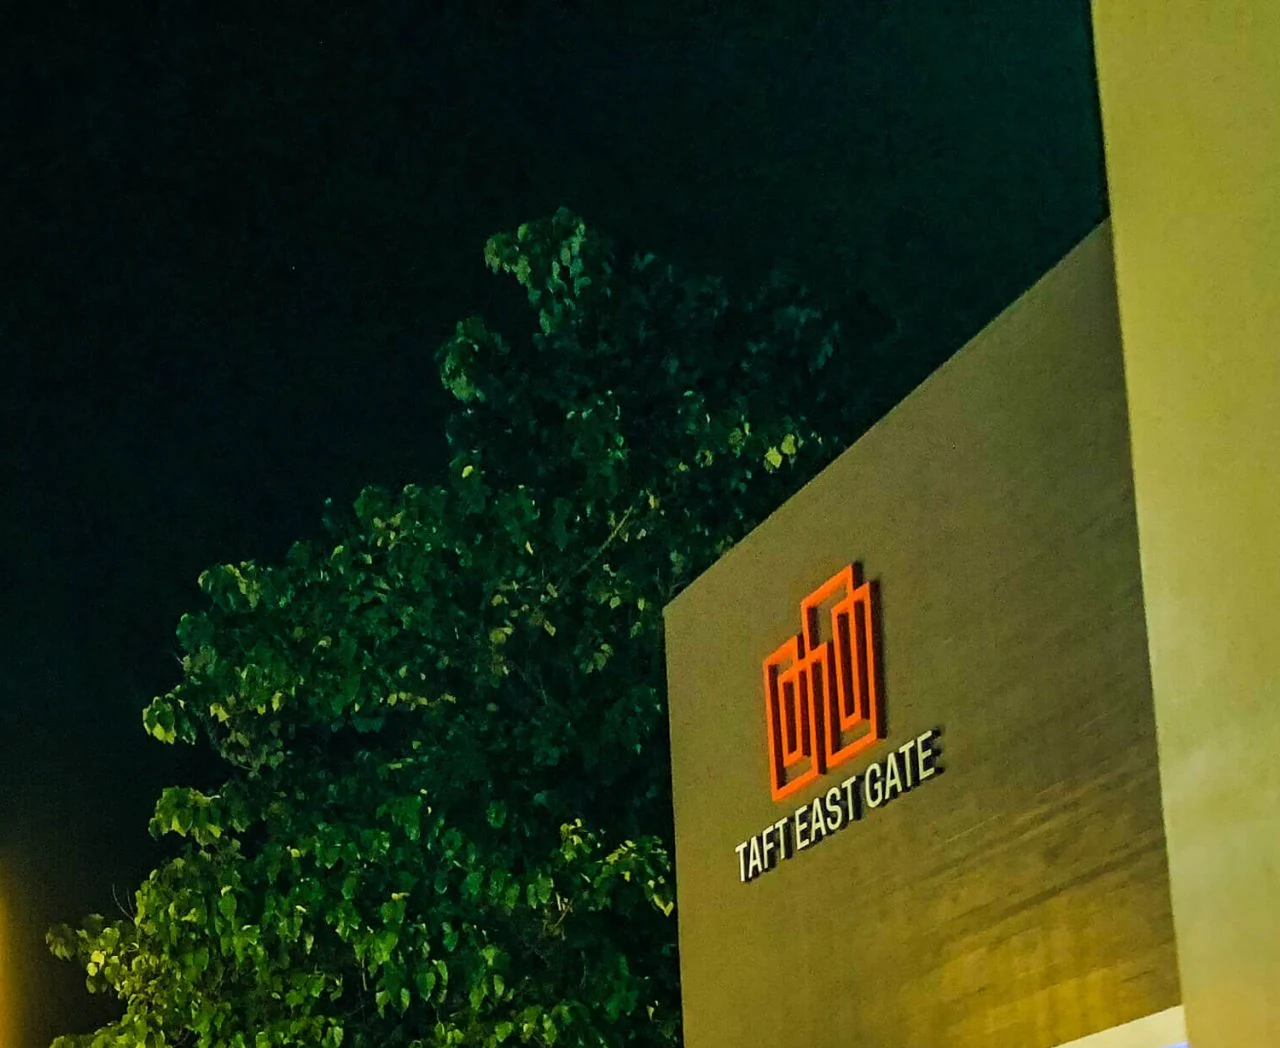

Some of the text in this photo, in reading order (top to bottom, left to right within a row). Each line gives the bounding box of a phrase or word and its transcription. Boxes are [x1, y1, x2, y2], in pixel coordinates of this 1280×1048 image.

[735, 730, 935, 882] TAFT EAST GATE
